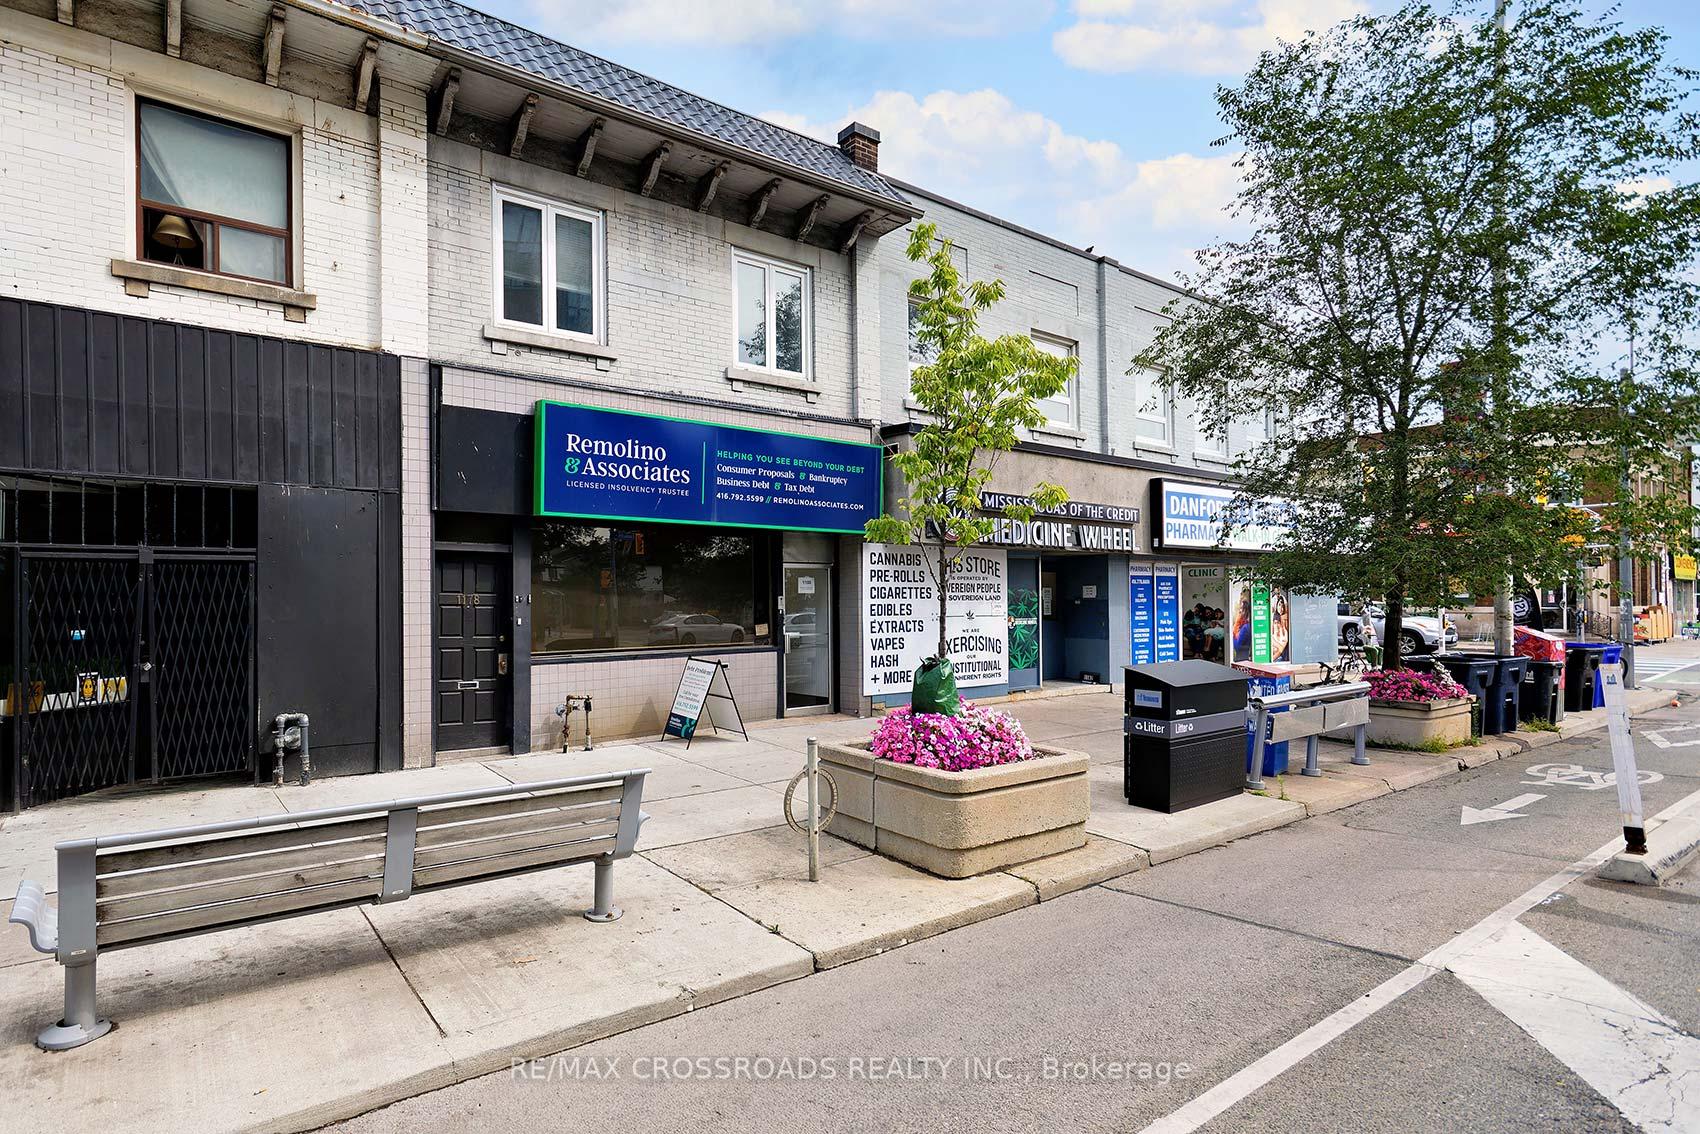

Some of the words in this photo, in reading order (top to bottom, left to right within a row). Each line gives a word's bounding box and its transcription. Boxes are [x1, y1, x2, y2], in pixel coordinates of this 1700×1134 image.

[566, 433, 666, 461] Remolino
[717, 450, 753, 461] HELPING
[756, 455, 773, 463] YOU
[775, 457, 791, 465] SEE
[793, 459, 823, 469] BEYOND
[825, 462, 845, 472] YOUR
[846, 465, 865, 474] DEBT
[581, 457, 690, 484] Associates
[716, 463, 757, 475] Consumer
[758, 467, 795, 480] Proposals
[799, 472, 806, 480] &
[809, 473, 848, 487] Bankruptcy
[566, 480, 606, 490] LICENSED
[608, 483, 656, 493] INSOLVENCY
[658, 487, 690, 497] TRUSTEE
[716, 476, 751, 488] Business
[752, 480, 770, 489] Debt
[774, 482, 781, 490] &
[784, 482, 797, 492] Tax
[799, 484, 815, 494] Debt
[716, 492, 764, 503] 416.792.5599
[773, 497, 864, 511] REMOLINOASSOCIATES.COM
[1070, 503, 1083, 516] OF
[1085, 505, 1104, 518] THE
[1106, 507, 1139, 522] CREDIT
[1079, 525, 1141, 551] WHEEL
[1166, 522, 1222, 540] PHARMAC
[870, 552, 921, 566] CANNABIS
[966, 556, 1001, 579] STORE
[1188, 568, 1218, 578] CLINIC
[870, 569, 925, 583] PRE-ROLLS
[870, 586, 932, 600] CIGARETTES
[977, 584, 1001, 594] PEOPLE
[870, 603, 912, 617] EDIBLES
[870, 620, 924, 634] EXTRACTS
[870, 637, 905, 651] VAPES
[870, 654, 899, 669] HASH
[871, 674, 880, 684] +
[884, 670, 912, 685] MORE
[1144, 721, 1165, 733] Litter
